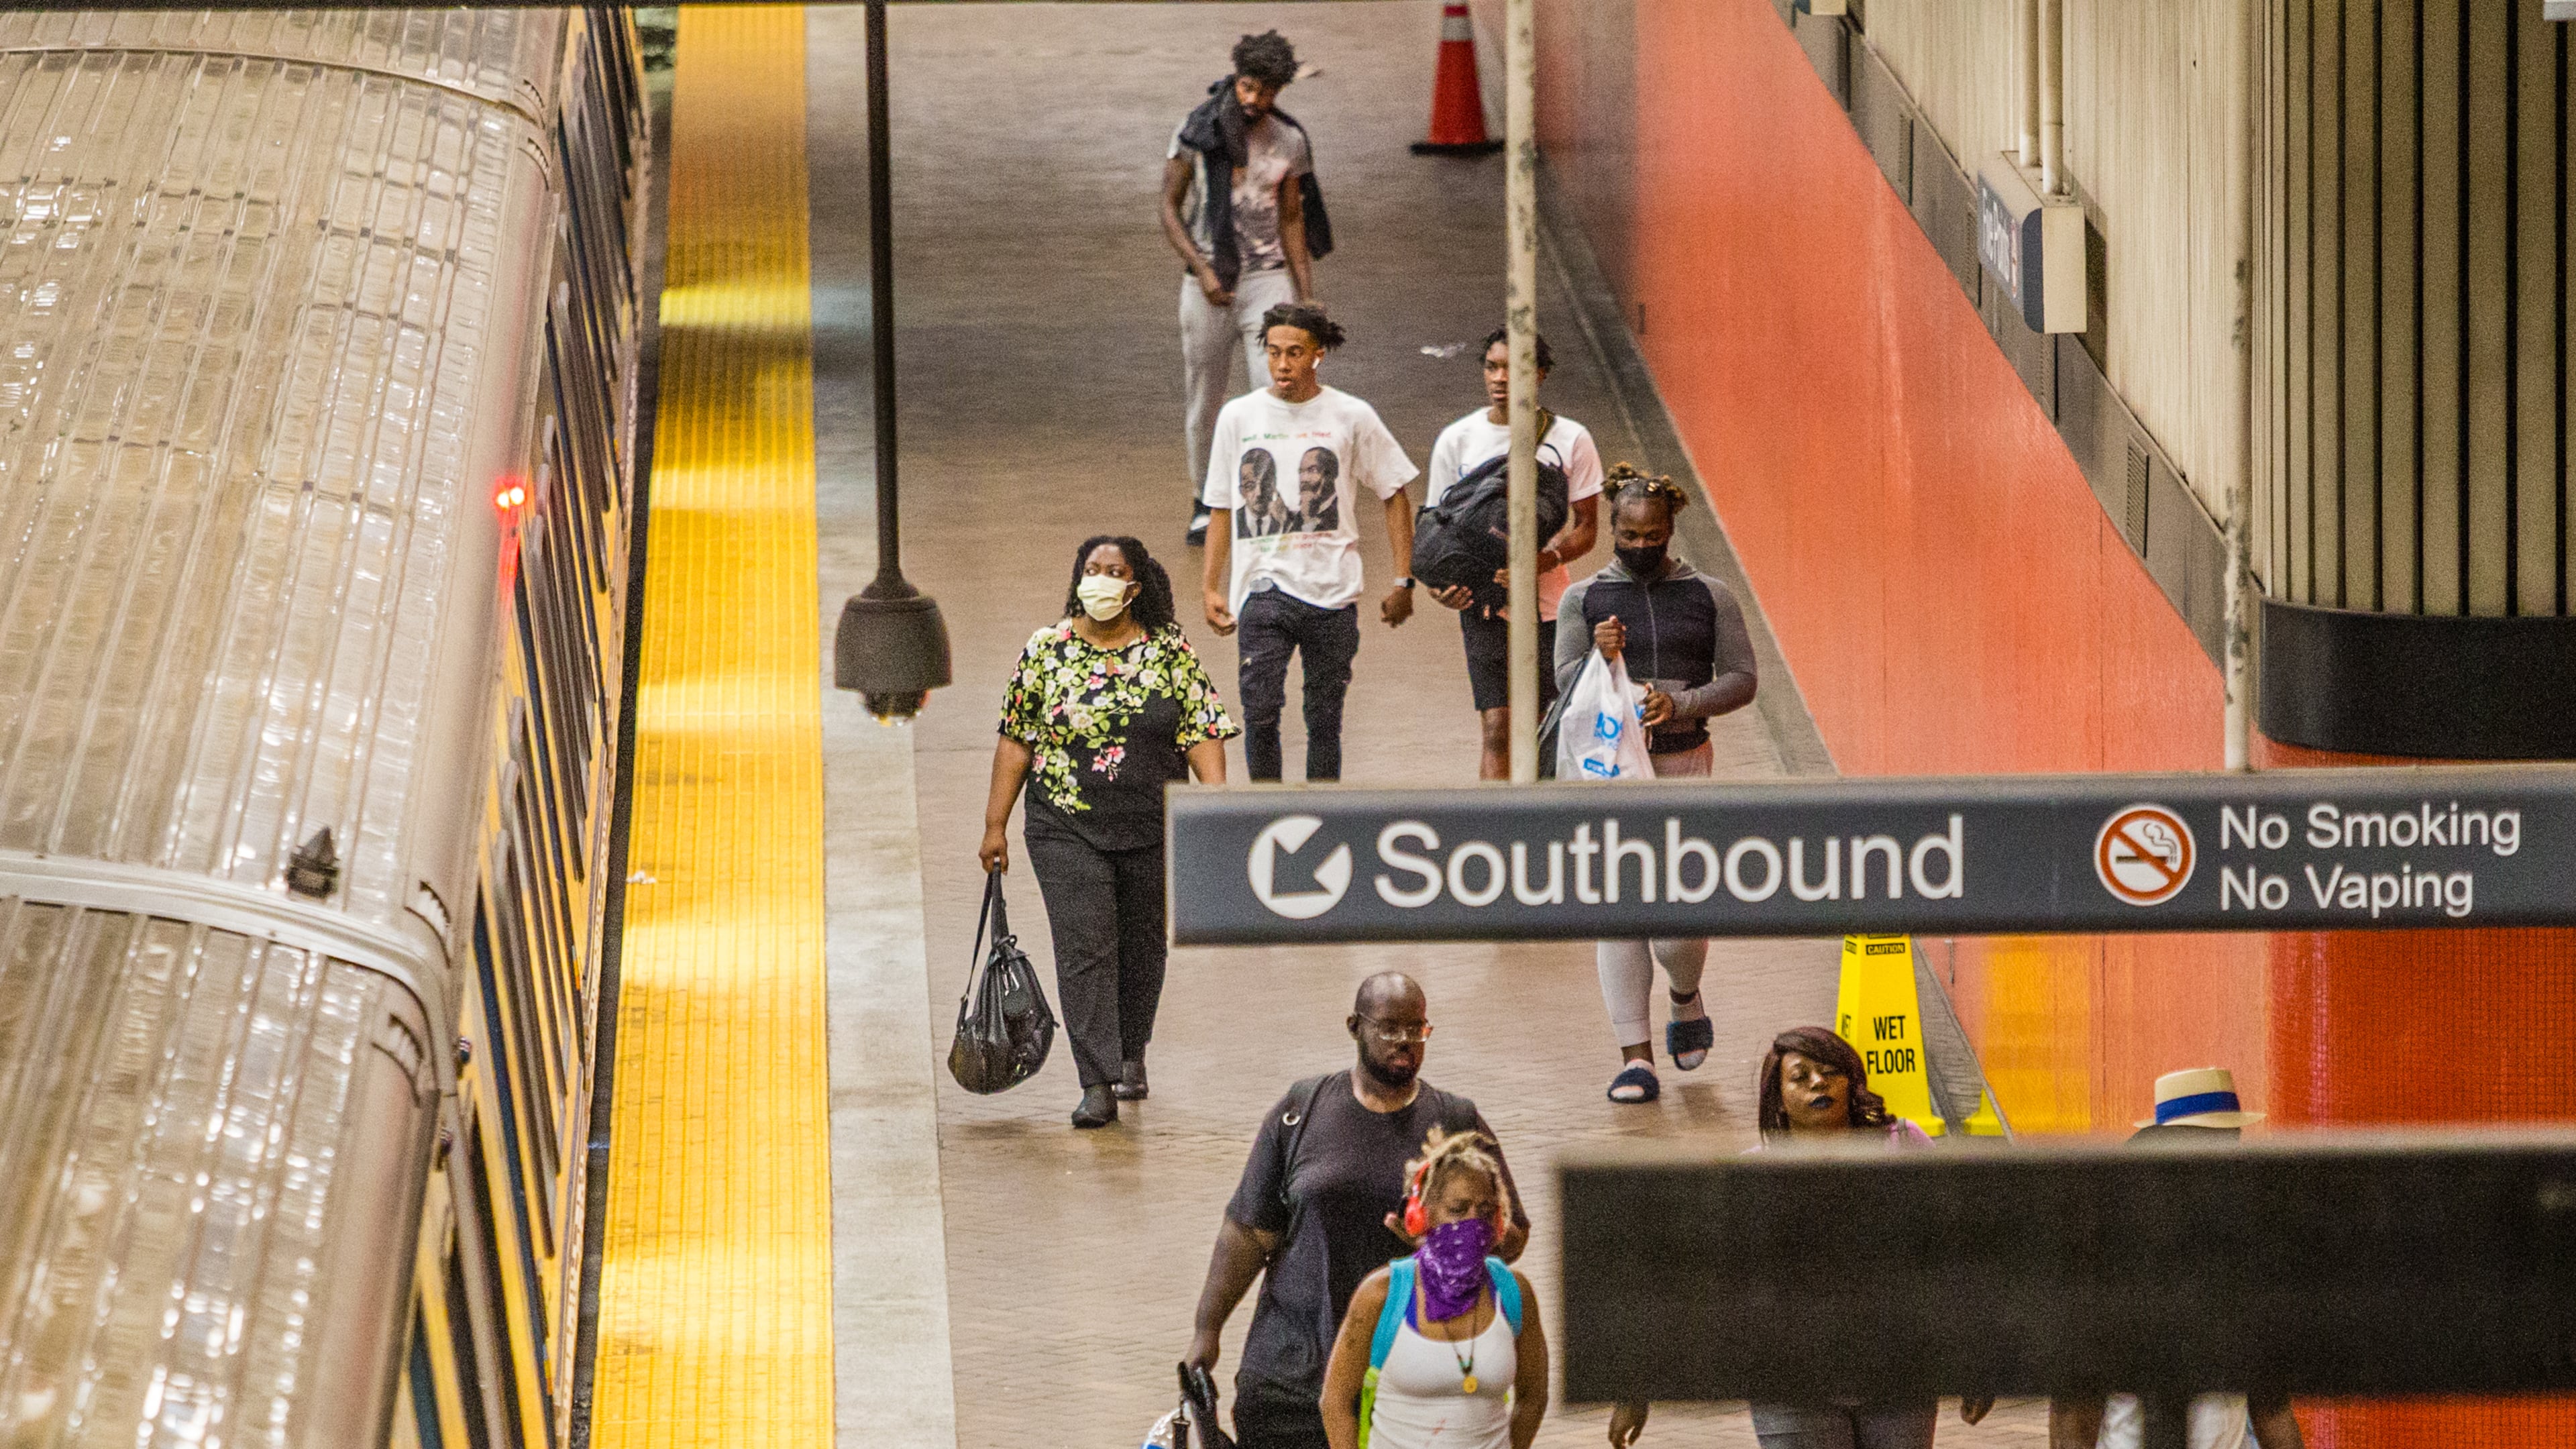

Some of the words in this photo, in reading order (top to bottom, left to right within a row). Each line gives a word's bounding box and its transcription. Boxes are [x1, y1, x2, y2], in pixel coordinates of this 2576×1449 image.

[2222, 806, 2289, 849] No
[2307, 803, 2520, 855] Smoking
[1375, 816, 1962, 907] Southbound
[2222, 867, 2289, 910] No
[2306, 865, 2472, 917] Vaping
[1867, 945, 1904, 954] CAUTION
[1874, 1016, 1904, 1040] WET
[1867, 1049, 1915, 1074] FLOOR
